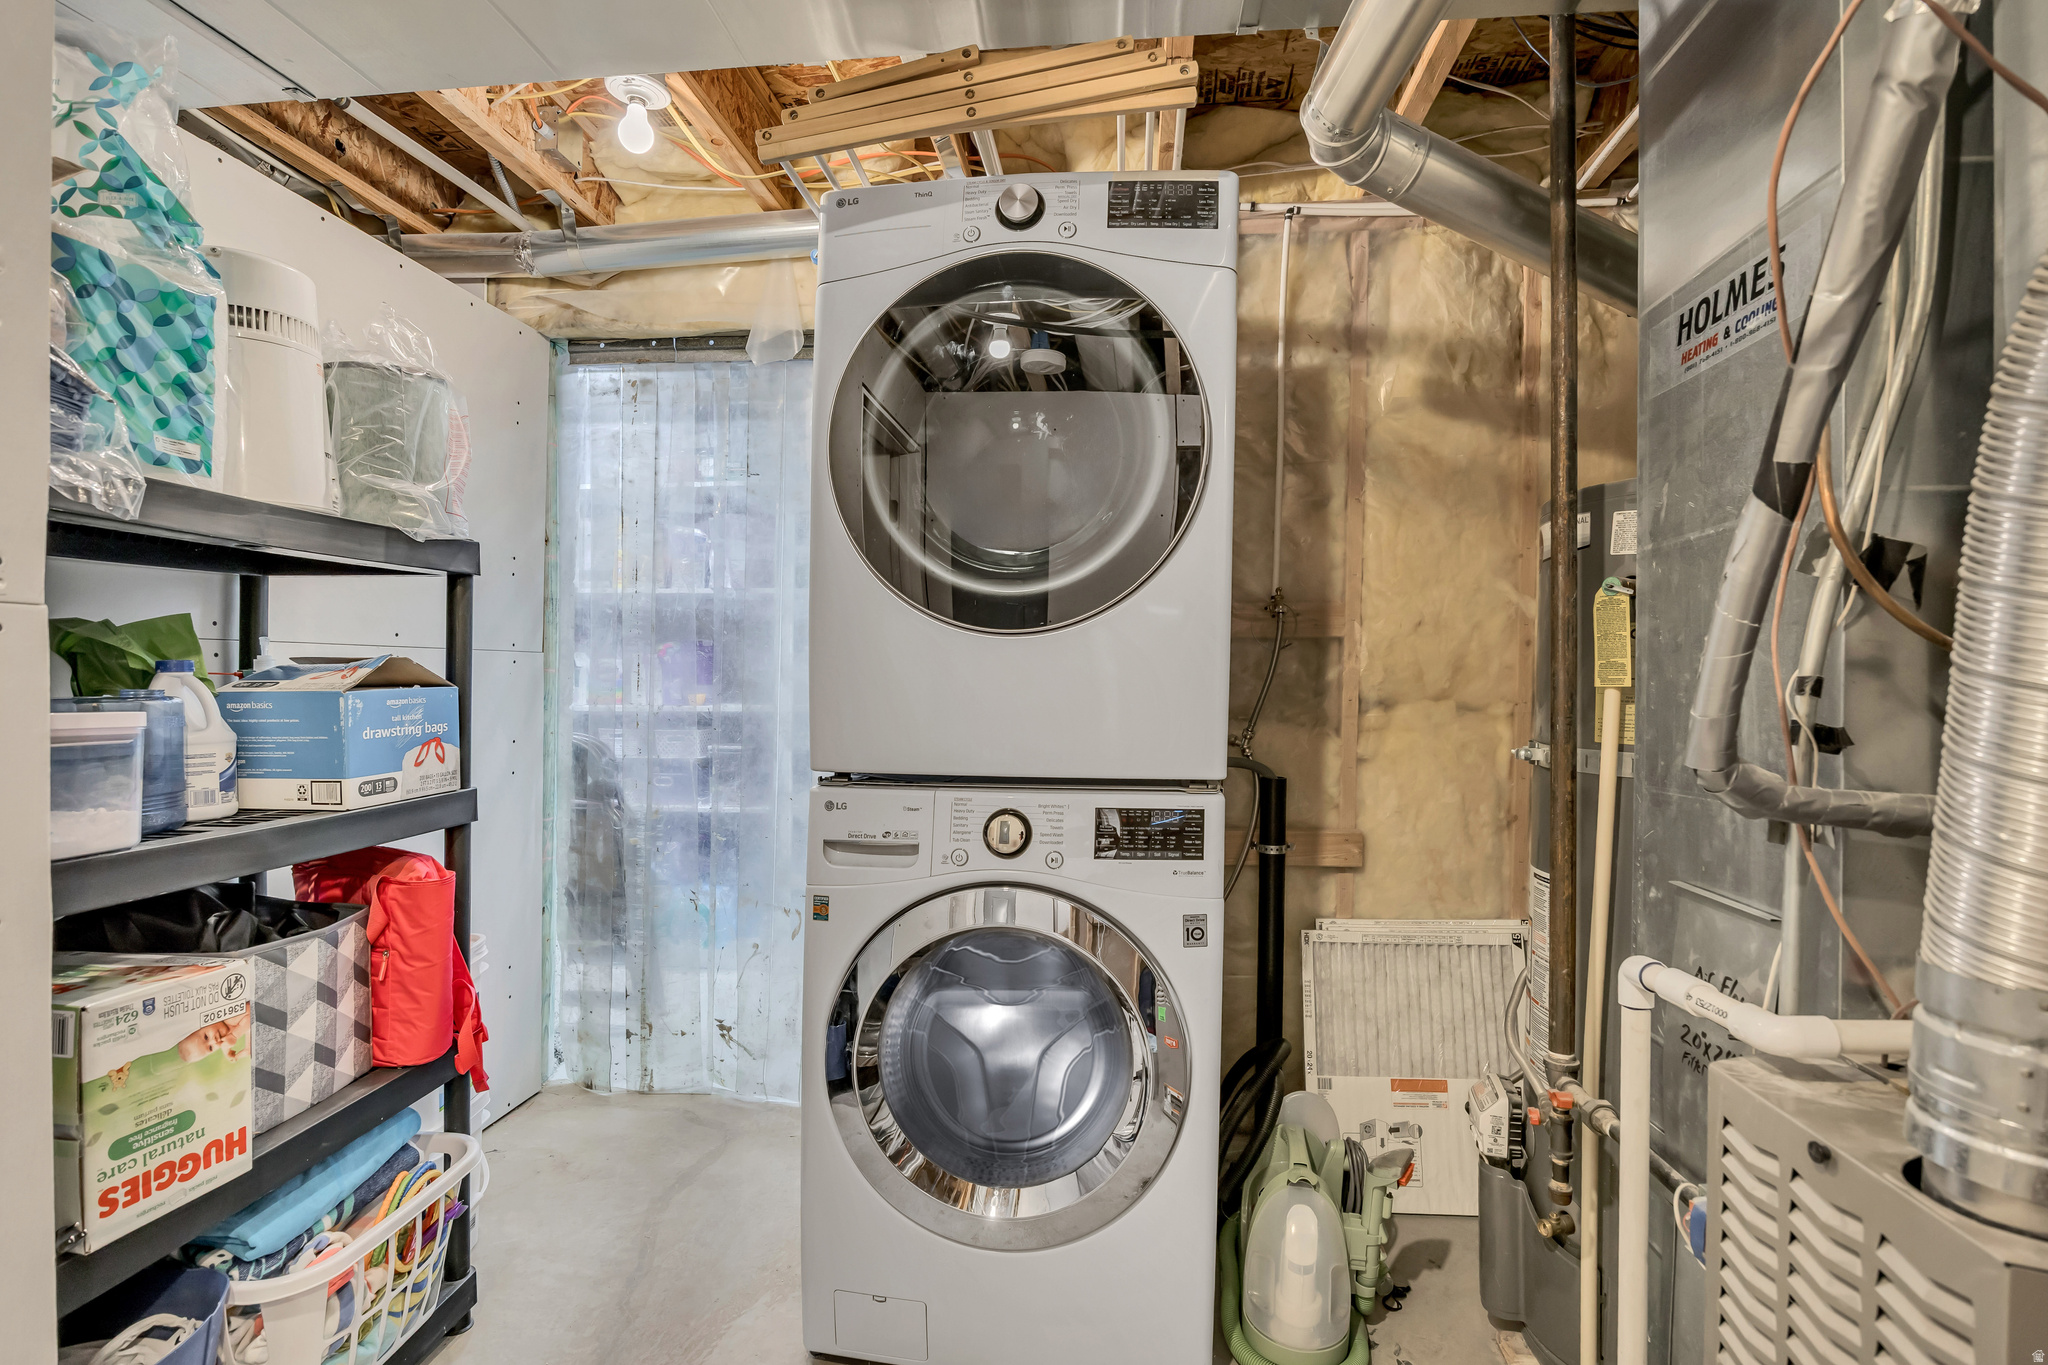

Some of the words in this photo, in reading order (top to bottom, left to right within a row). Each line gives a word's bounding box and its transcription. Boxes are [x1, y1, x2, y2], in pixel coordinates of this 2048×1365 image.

[847, 198, 859, 206] LG
[1680, 332, 1719, 366] HEATING
[1723, 326, 1731, 340] &
[391, 714, 401, 722] tall
[402, 713, 423, 721] kitchen
[362, 723, 423, 740] drawstring
[425, 721, 448, 735] bags
[360, 783, 372, 793] 200
[375, 781, 382, 790] 13
[836, 802, 847, 810] LG
[1186, 926, 1205, 941] 10
[195, 984, 208, 995] AUX
[209, 981, 220, 991] PAS
[163, 988, 194, 1006] TOILETTES
[191, 994, 207, 1011] NOT
[209, 992, 220, 1002] DO
[163, 999, 189, 1020] FLUSH
[203, 1002, 245, 1023] 5361302
[115, 1010, 139, 1027] 624
[1307, 1050, 1313, 1059] 20
[1682, 1051, 1708, 1076] Filter
[133, 1107, 158, 1121] parfum
[135, 1108, 173, 1128] délicates
[144, 1118, 178, 1133] fragrance
[128, 1131, 143, 1143] free
[132, 1126, 175, 1149] sensitive
[143, 1127, 206, 1167] natural
[96, 1159, 138, 1183] care
[97, 1125, 247, 1219] HUGGIES
